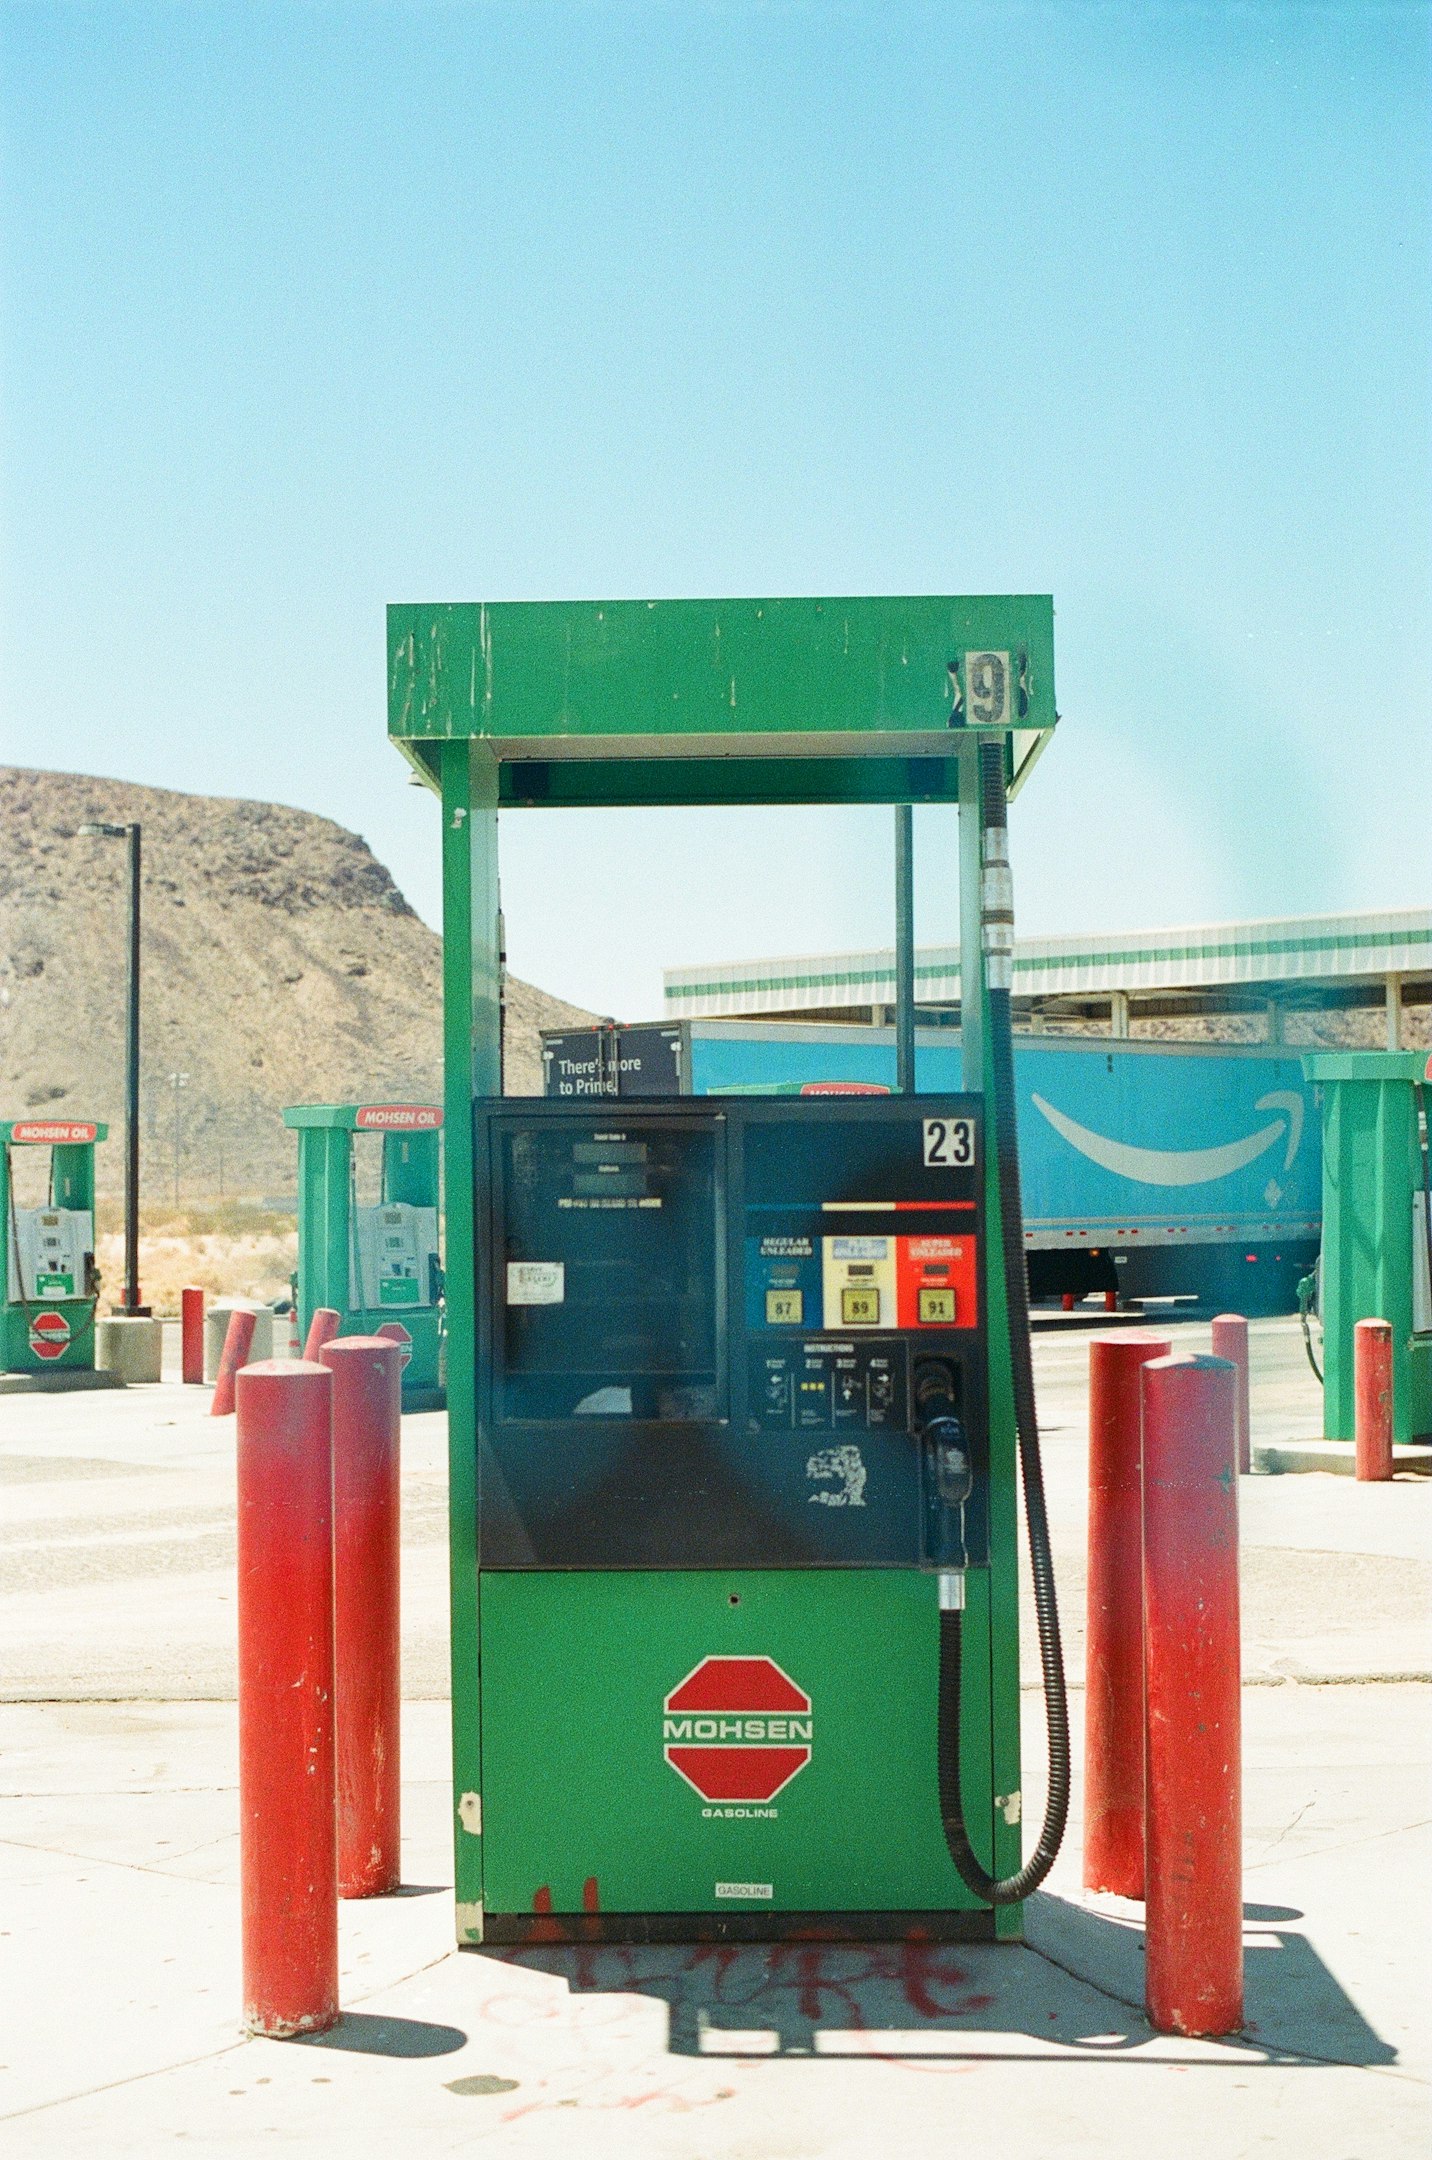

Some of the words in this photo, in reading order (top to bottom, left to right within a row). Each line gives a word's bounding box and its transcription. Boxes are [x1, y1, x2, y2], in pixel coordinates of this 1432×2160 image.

[971, 653, 1005, 722] 9
[559, 1081, 573, 1095] to
[364, 1111, 415, 1124] MOHSEN
[417, 1111, 435, 1124] OIL
[20, 1126, 69, 1139] MOHSEN
[71, 1127, 89, 1139] OIL
[927, 1121, 970, 1163] 23
[775, 1302, 792, 1314] 87
[852, 1302, 869, 1313] 89
[928, 1302, 945, 1313] 91
[663, 1720, 813, 1739] MOHSEN
[702, 1808, 778, 1818] GASOLINE
[718, 1885, 770, 1896] GASOLINE
